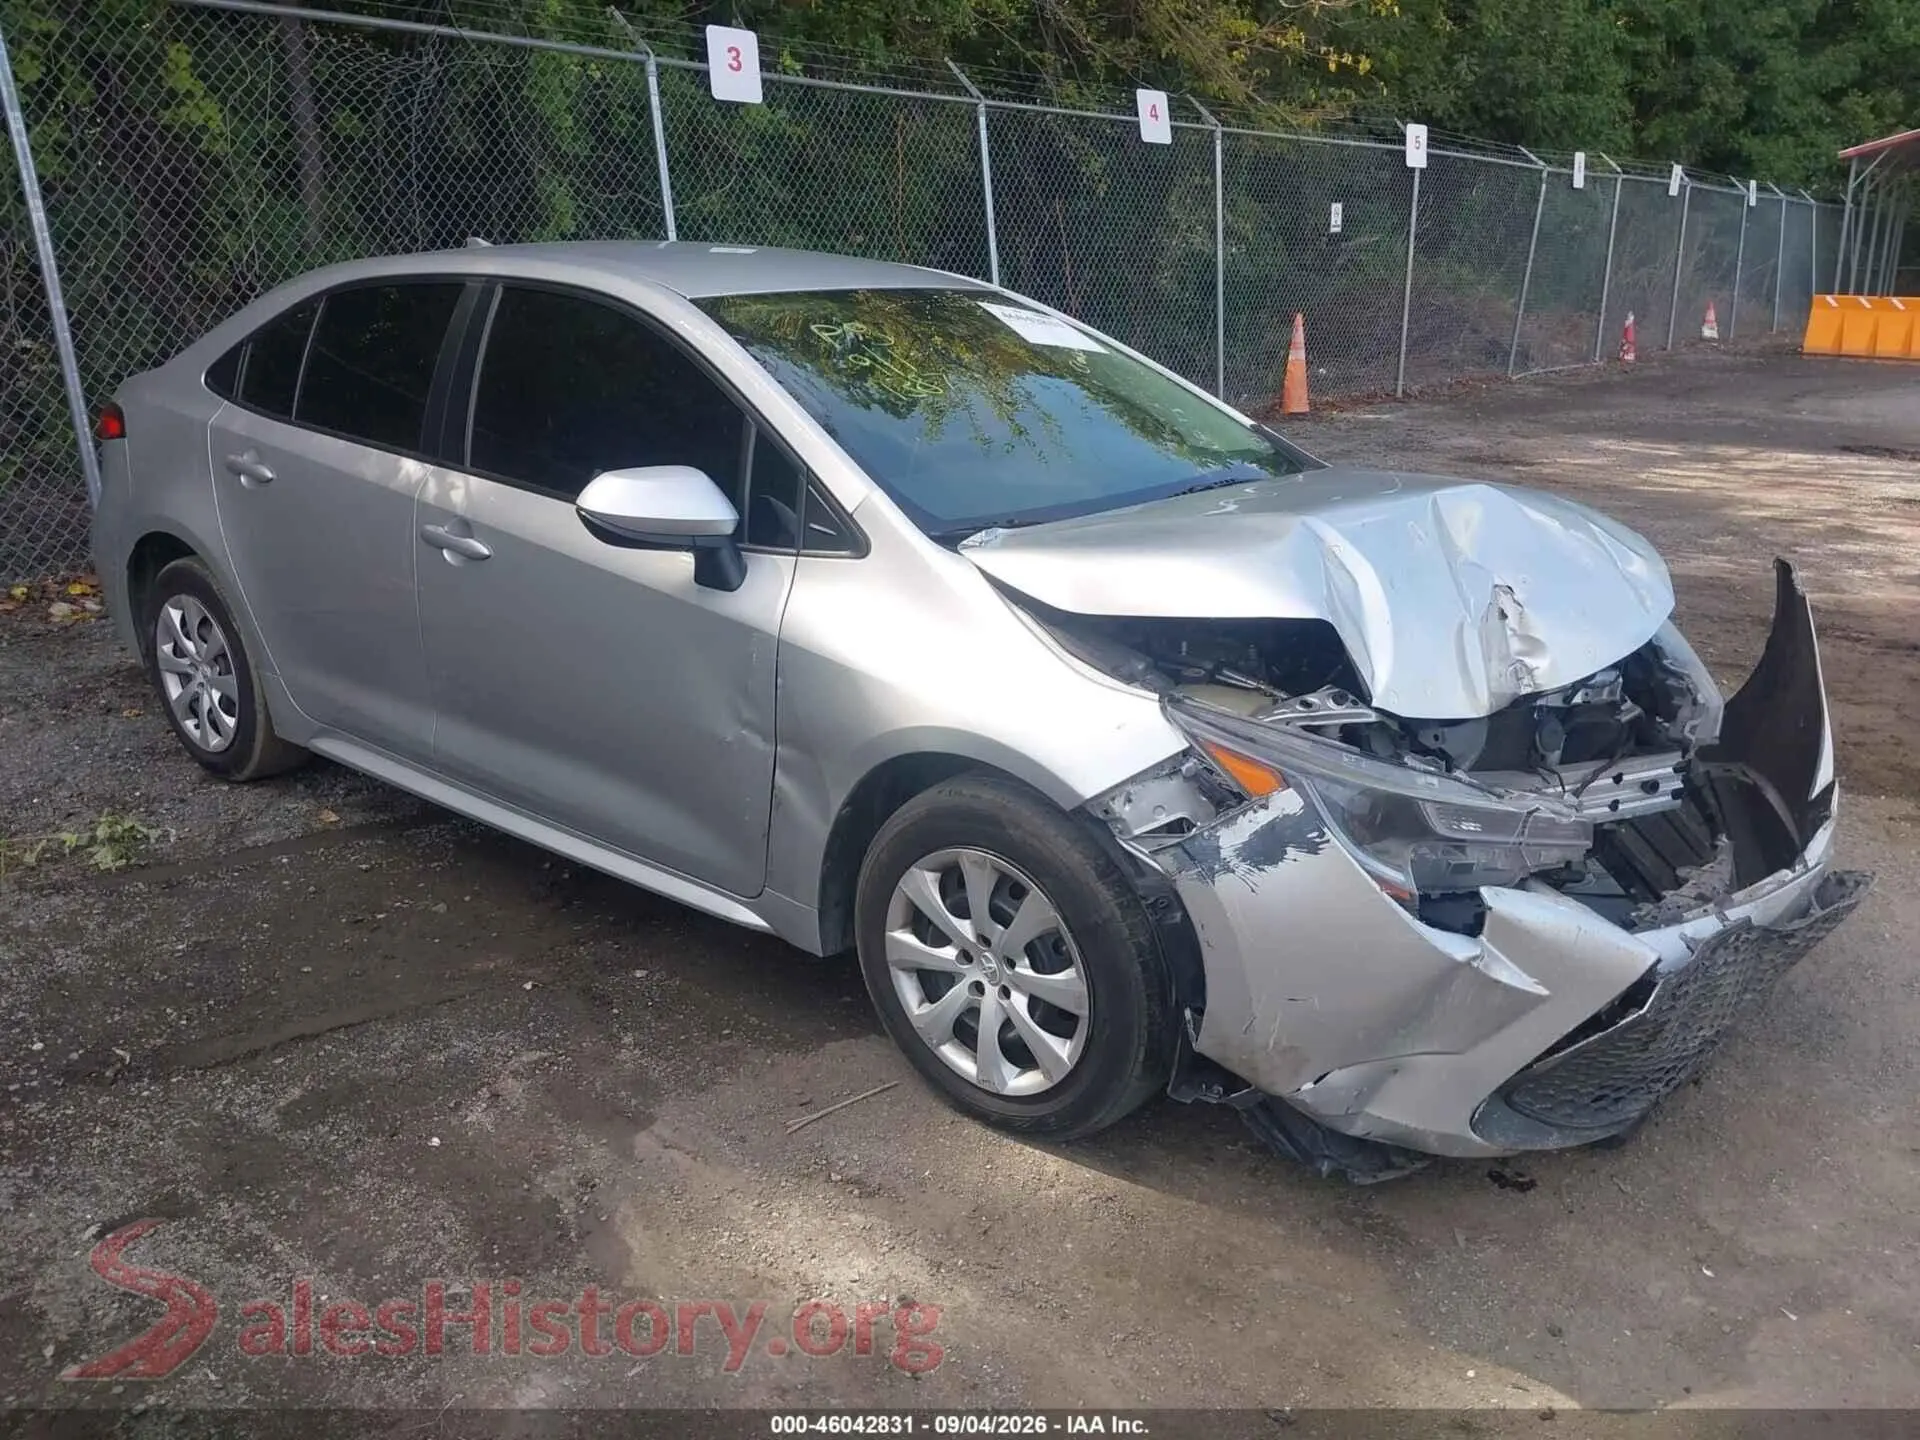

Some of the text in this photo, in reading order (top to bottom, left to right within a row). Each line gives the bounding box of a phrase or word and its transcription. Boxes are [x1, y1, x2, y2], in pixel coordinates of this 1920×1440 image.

[727, 46, 742, 72] 3
[1150, 103, 1159, 121] 4
[1415, 135, 1421, 150] 5
